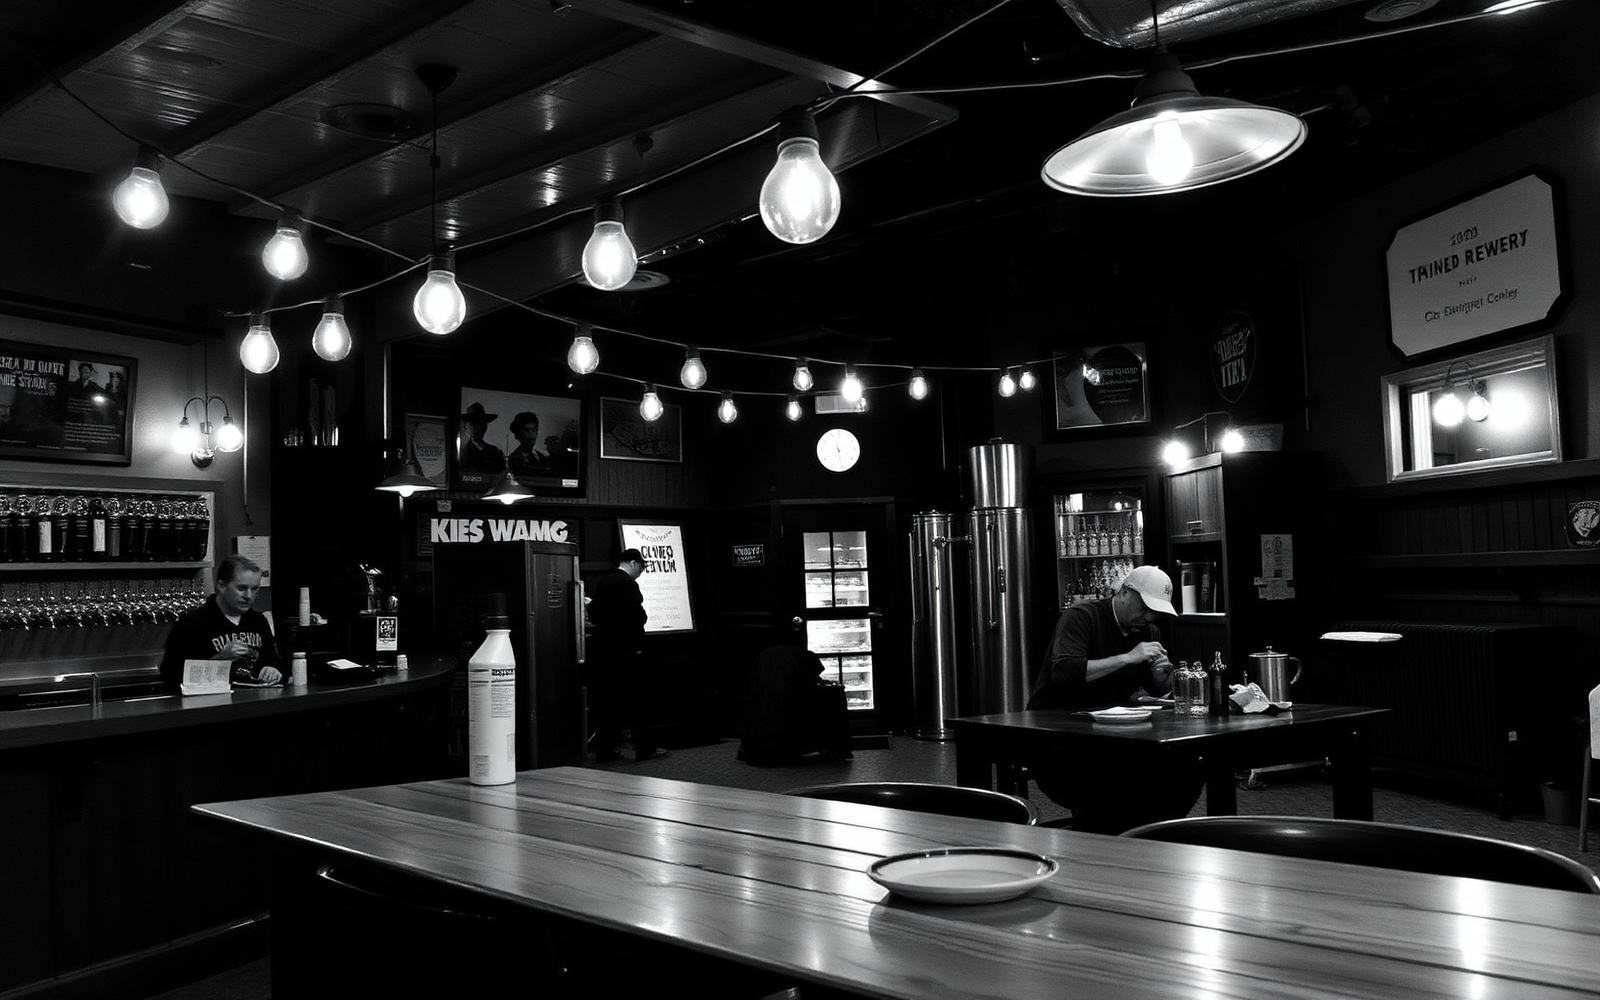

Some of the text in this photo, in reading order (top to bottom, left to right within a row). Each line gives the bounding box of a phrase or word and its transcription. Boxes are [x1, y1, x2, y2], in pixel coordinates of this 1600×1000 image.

[1465, 229, 1529, 266] REWERY
[430, 518, 568, 543] KIES WAMG
